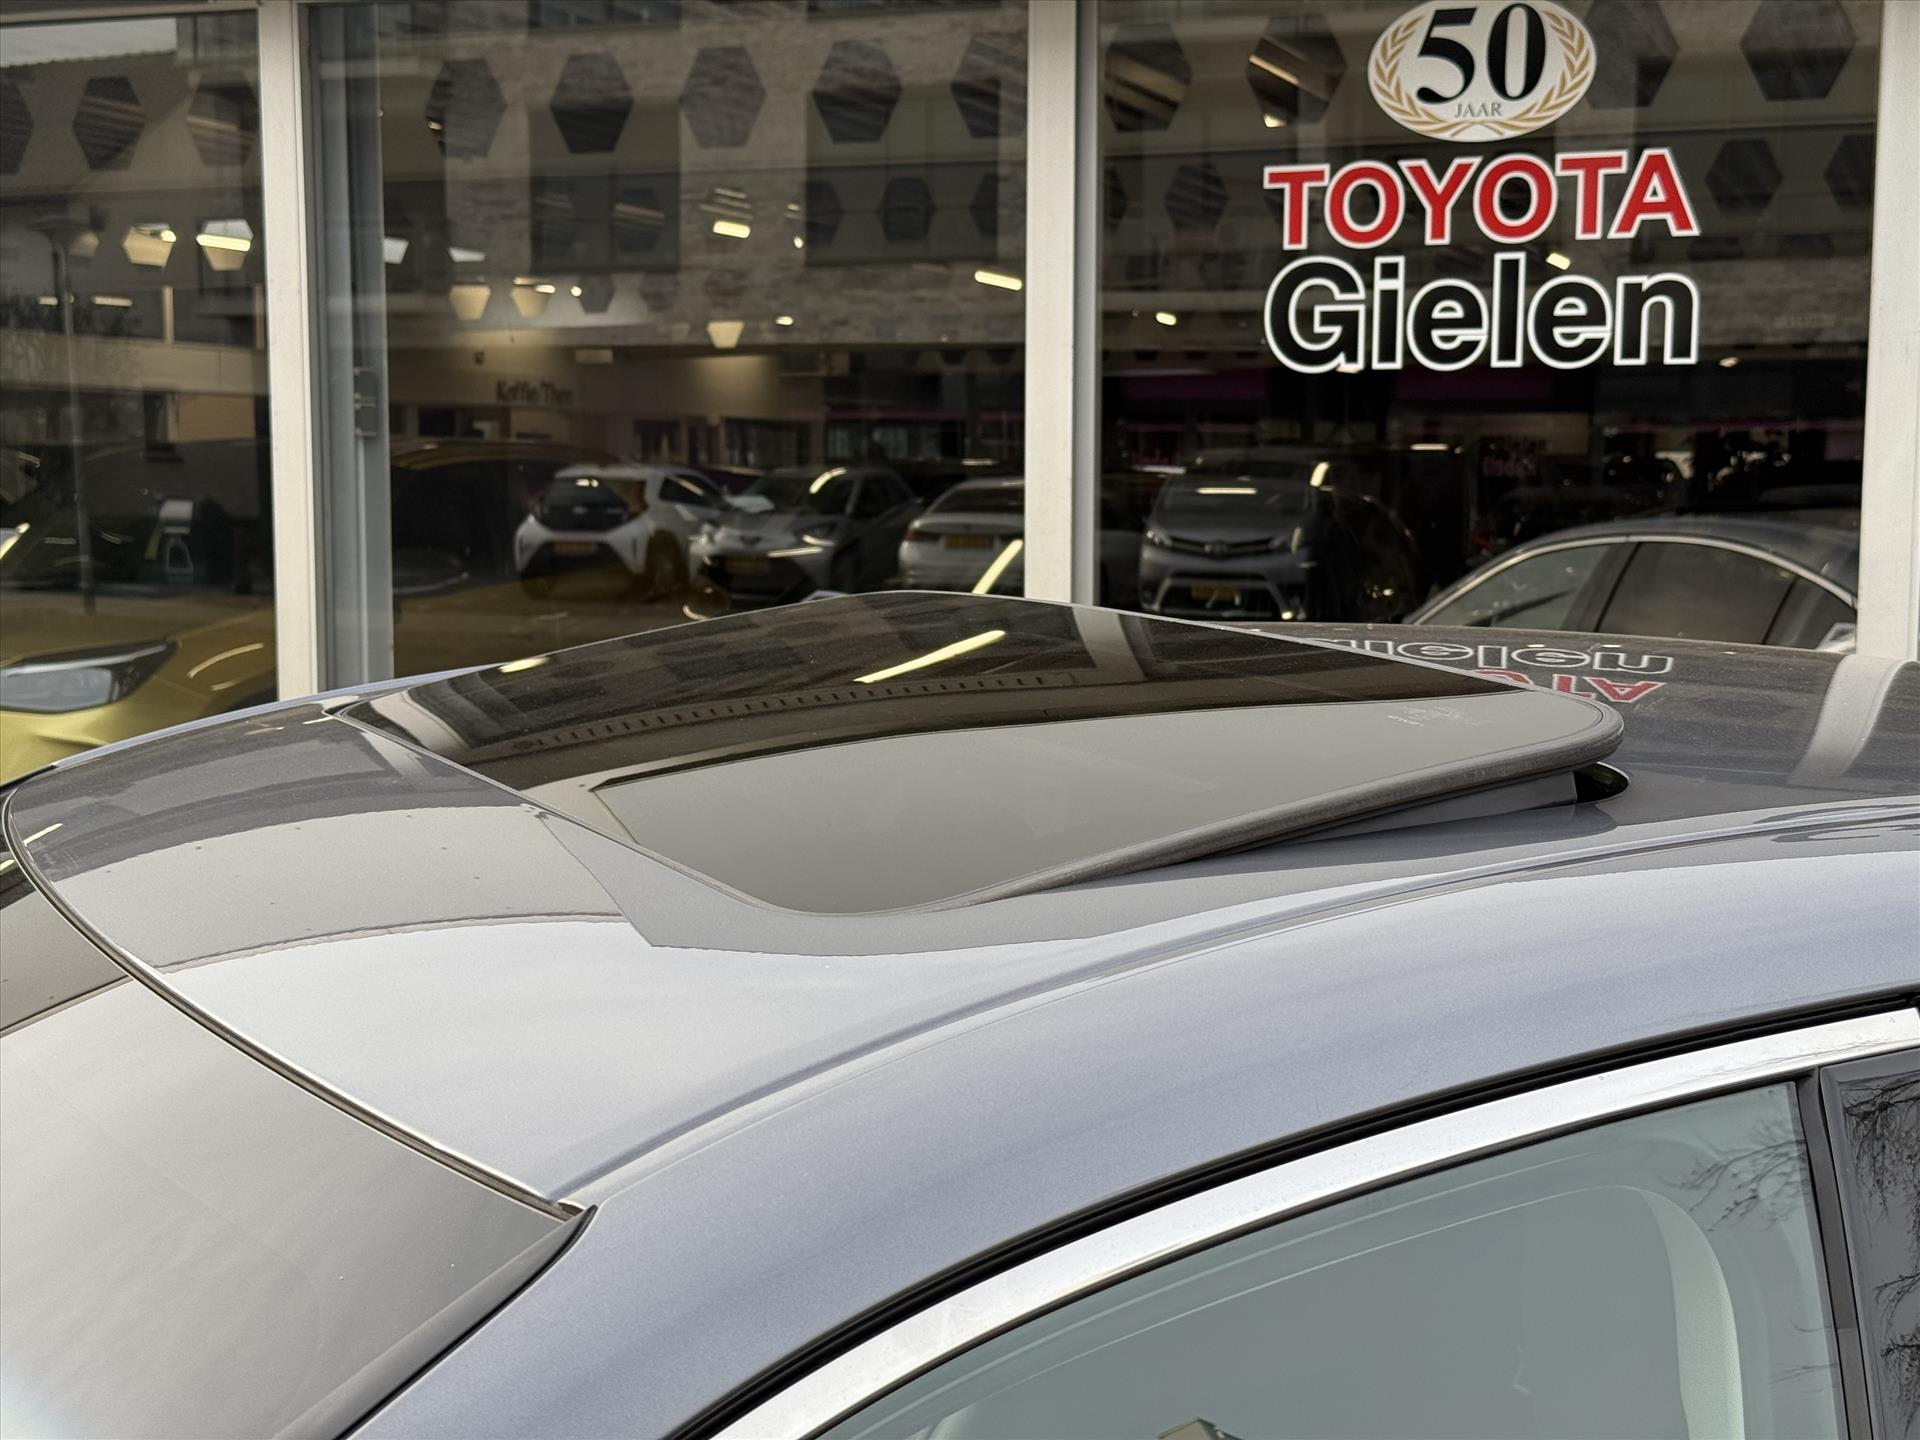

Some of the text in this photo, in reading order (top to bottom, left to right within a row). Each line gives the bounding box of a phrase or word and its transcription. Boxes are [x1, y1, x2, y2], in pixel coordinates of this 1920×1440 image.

[1416, 3, 1546, 104] 50
[1454, 102, 1503, 119] JAAR
[1264, 147, 1701, 250] TOYOTA
[1264, 252, 1698, 374] Gielen
